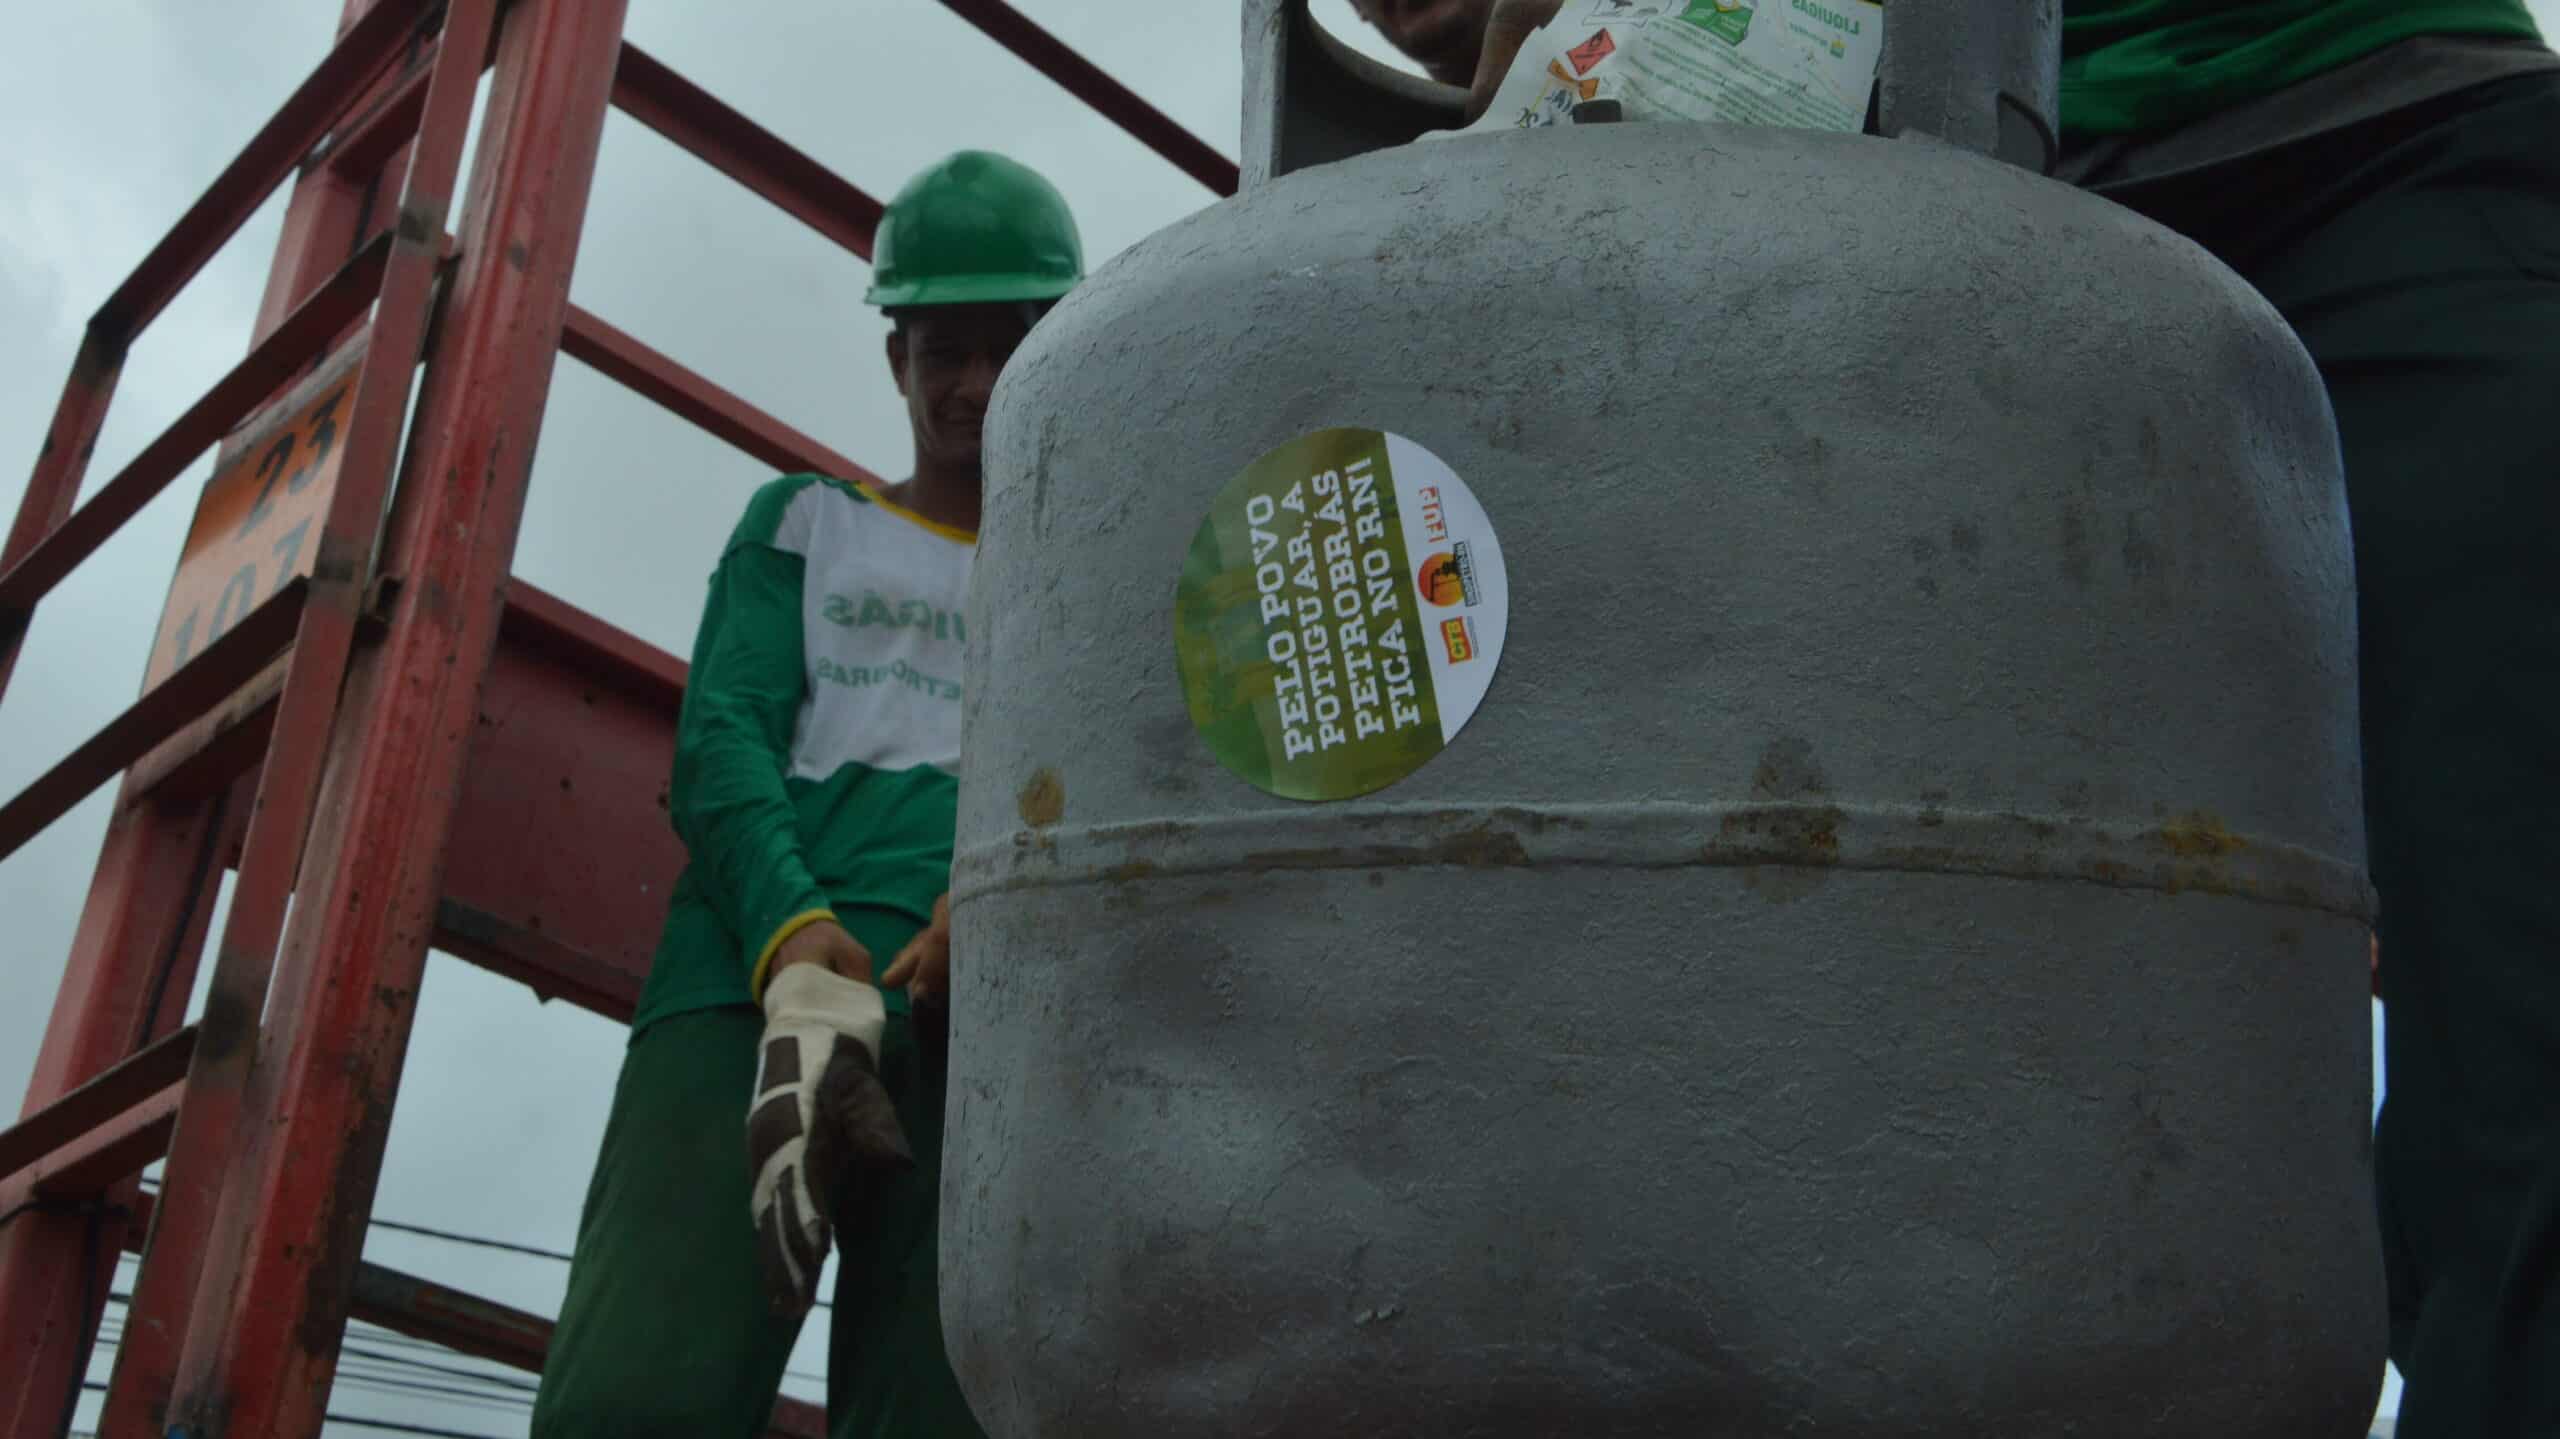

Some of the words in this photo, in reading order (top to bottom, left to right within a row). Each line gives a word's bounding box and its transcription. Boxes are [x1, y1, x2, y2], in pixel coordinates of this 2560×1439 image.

[1281, 480, 1306, 513] A
[1345, 456, 1385, 544] RN!
[1246, 493, 1291, 625] POVO
[1312, 469, 1385, 740] PETROBRÁS
[1362, 548, 1399, 619] NO
[1287, 519, 1346, 750] POTIGUAR,
[1379, 621, 1422, 731] FICA
[1267, 631, 1315, 761] PELO
